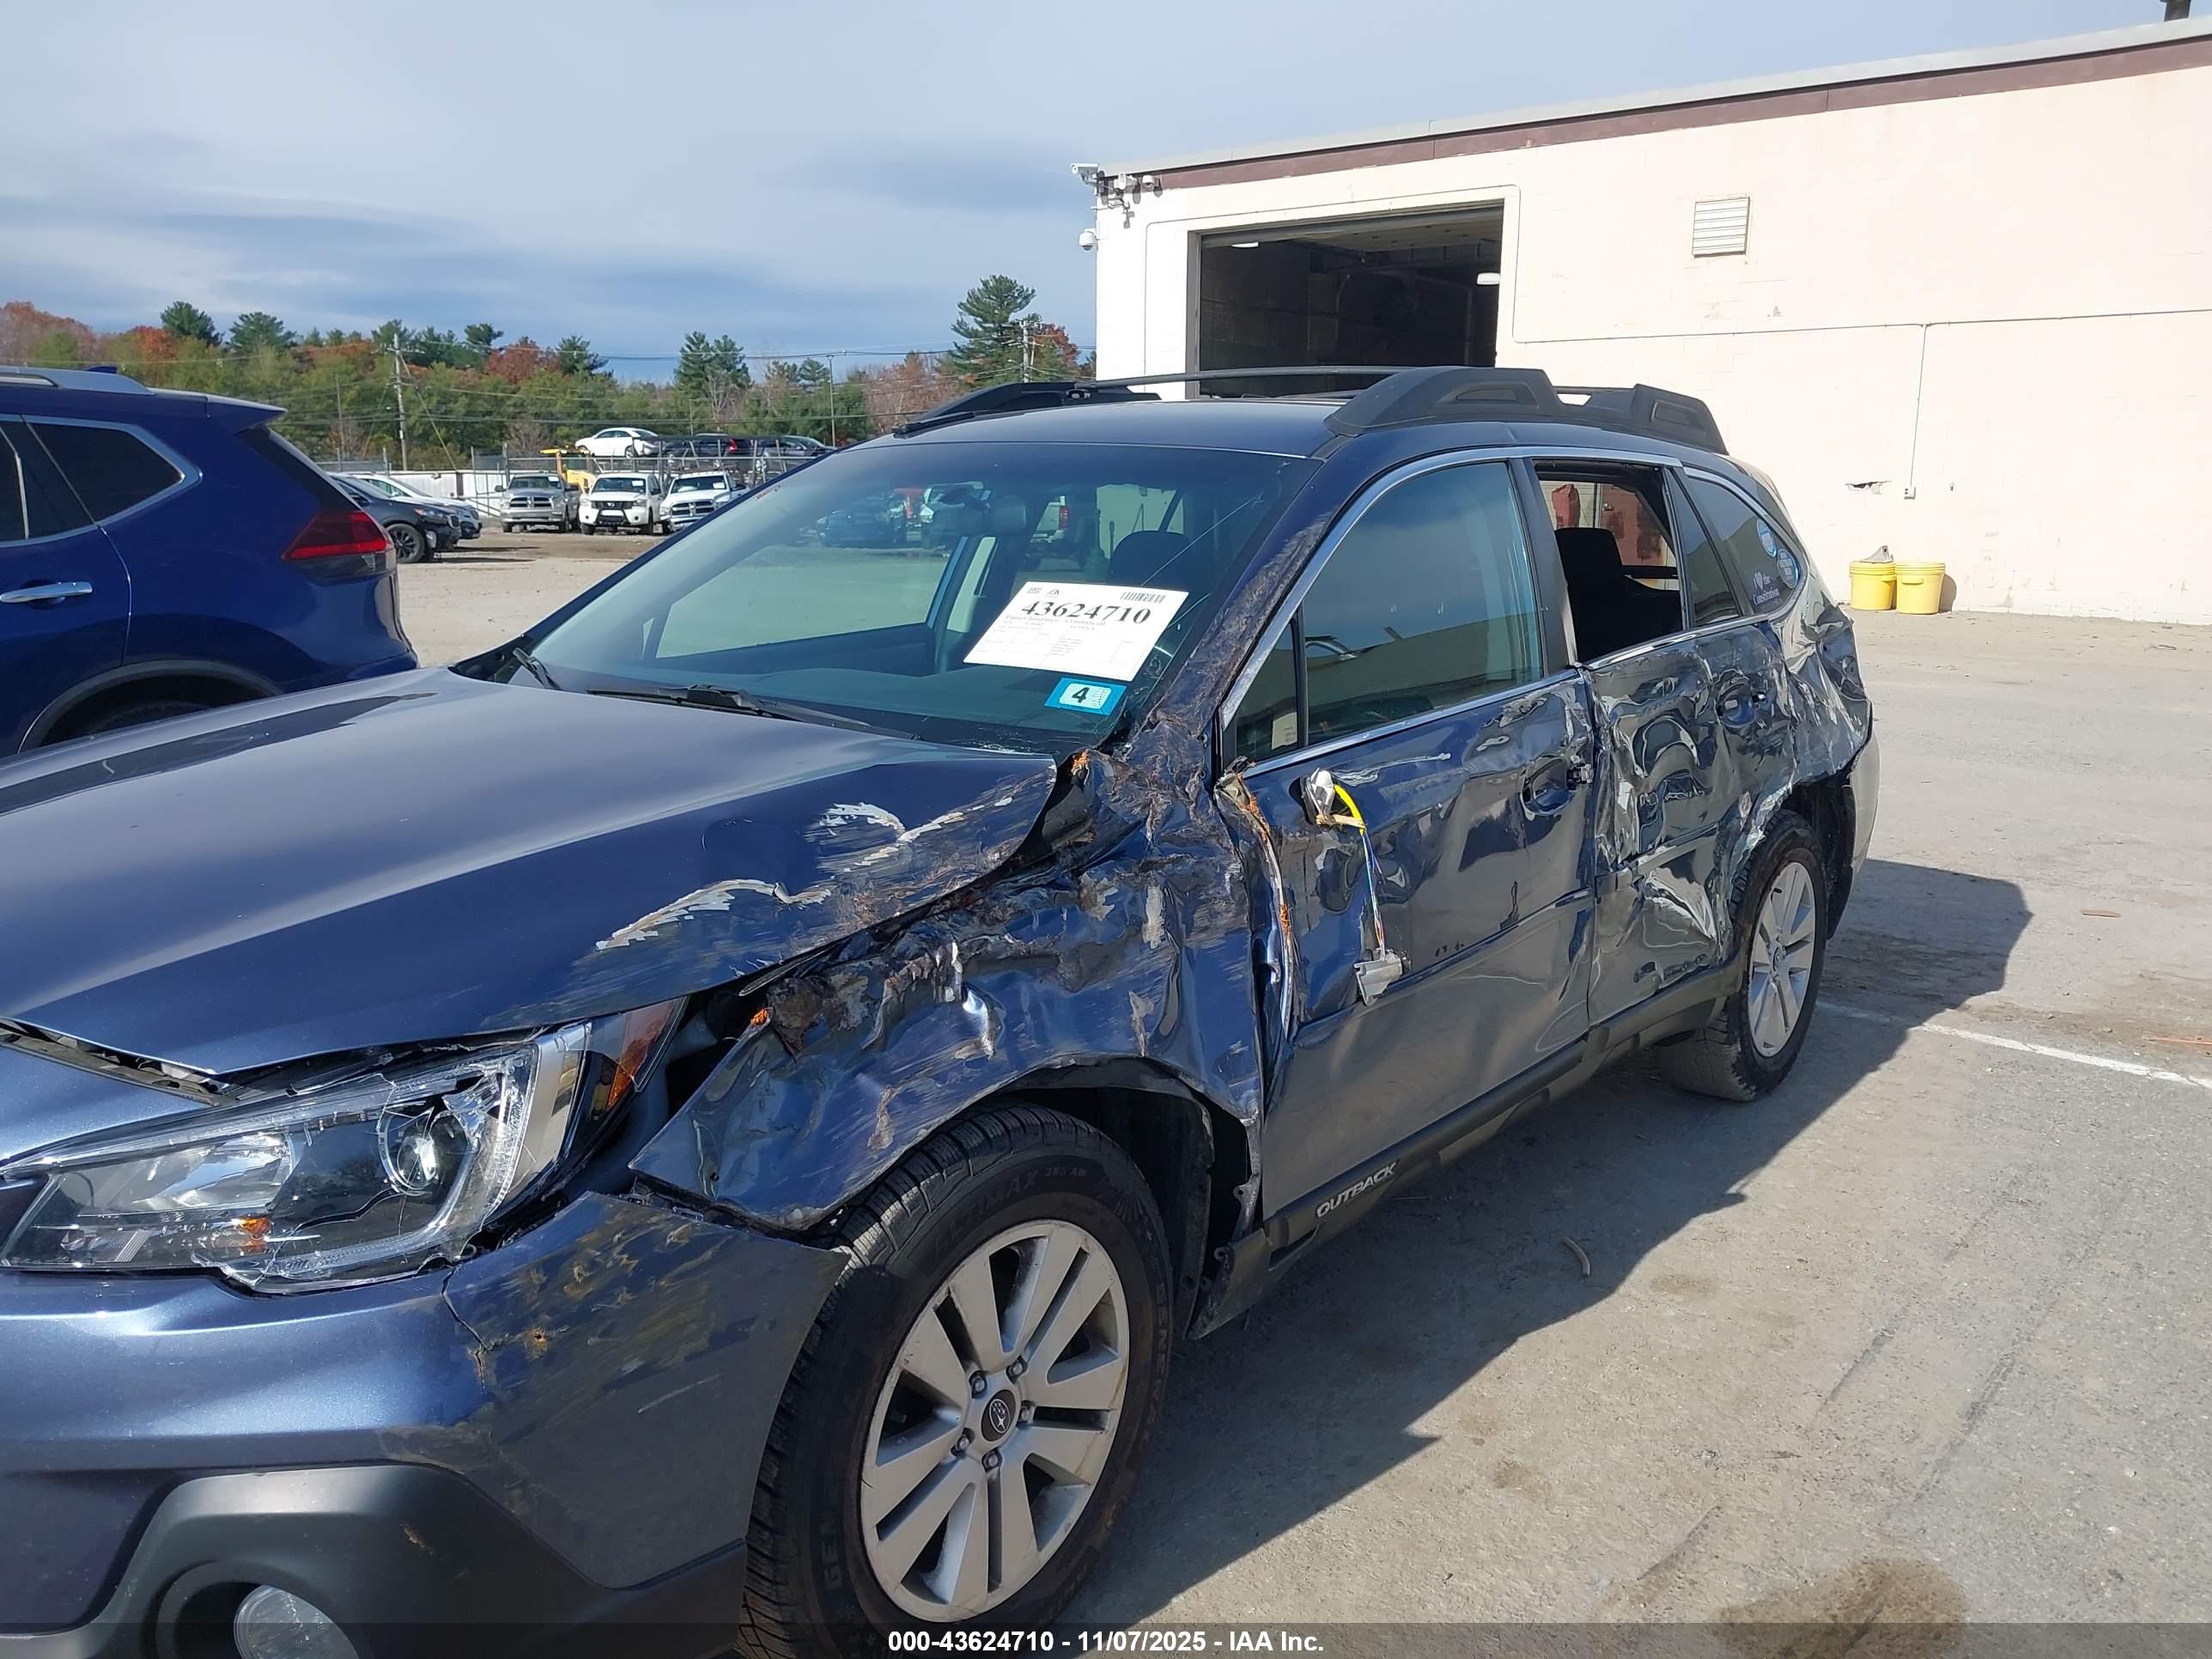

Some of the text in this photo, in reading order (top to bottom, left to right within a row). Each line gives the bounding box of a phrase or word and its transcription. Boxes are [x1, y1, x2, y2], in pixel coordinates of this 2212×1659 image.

[1021, 600, 1152, 624] 43624710
[1071, 686, 1091, 703] 4
[1316, 1161, 1397, 1218] OUTBACK
